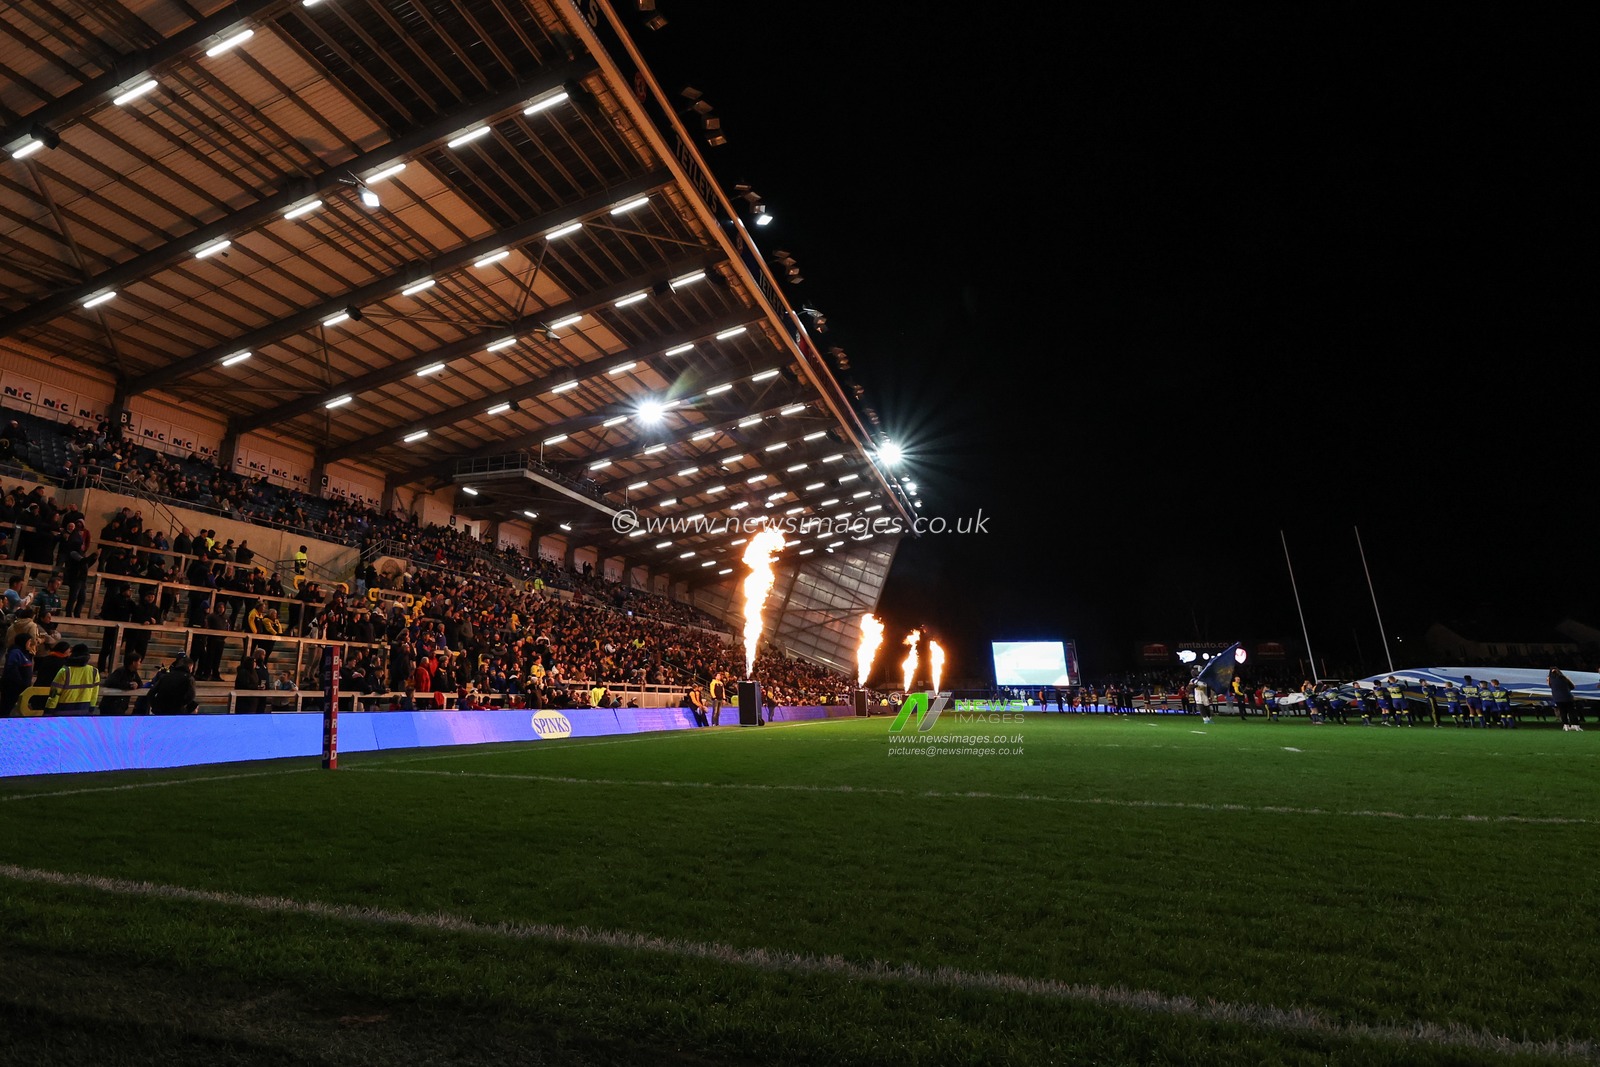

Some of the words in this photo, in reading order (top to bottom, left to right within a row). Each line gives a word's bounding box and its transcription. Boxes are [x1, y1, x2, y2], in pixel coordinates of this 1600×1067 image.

[120, 411, 128, 423] B
[322, 656, 331, 760] BETFRED
[330, 655, 339, 760] BETFRED
[533, 717, 570, 734] SPINKS
